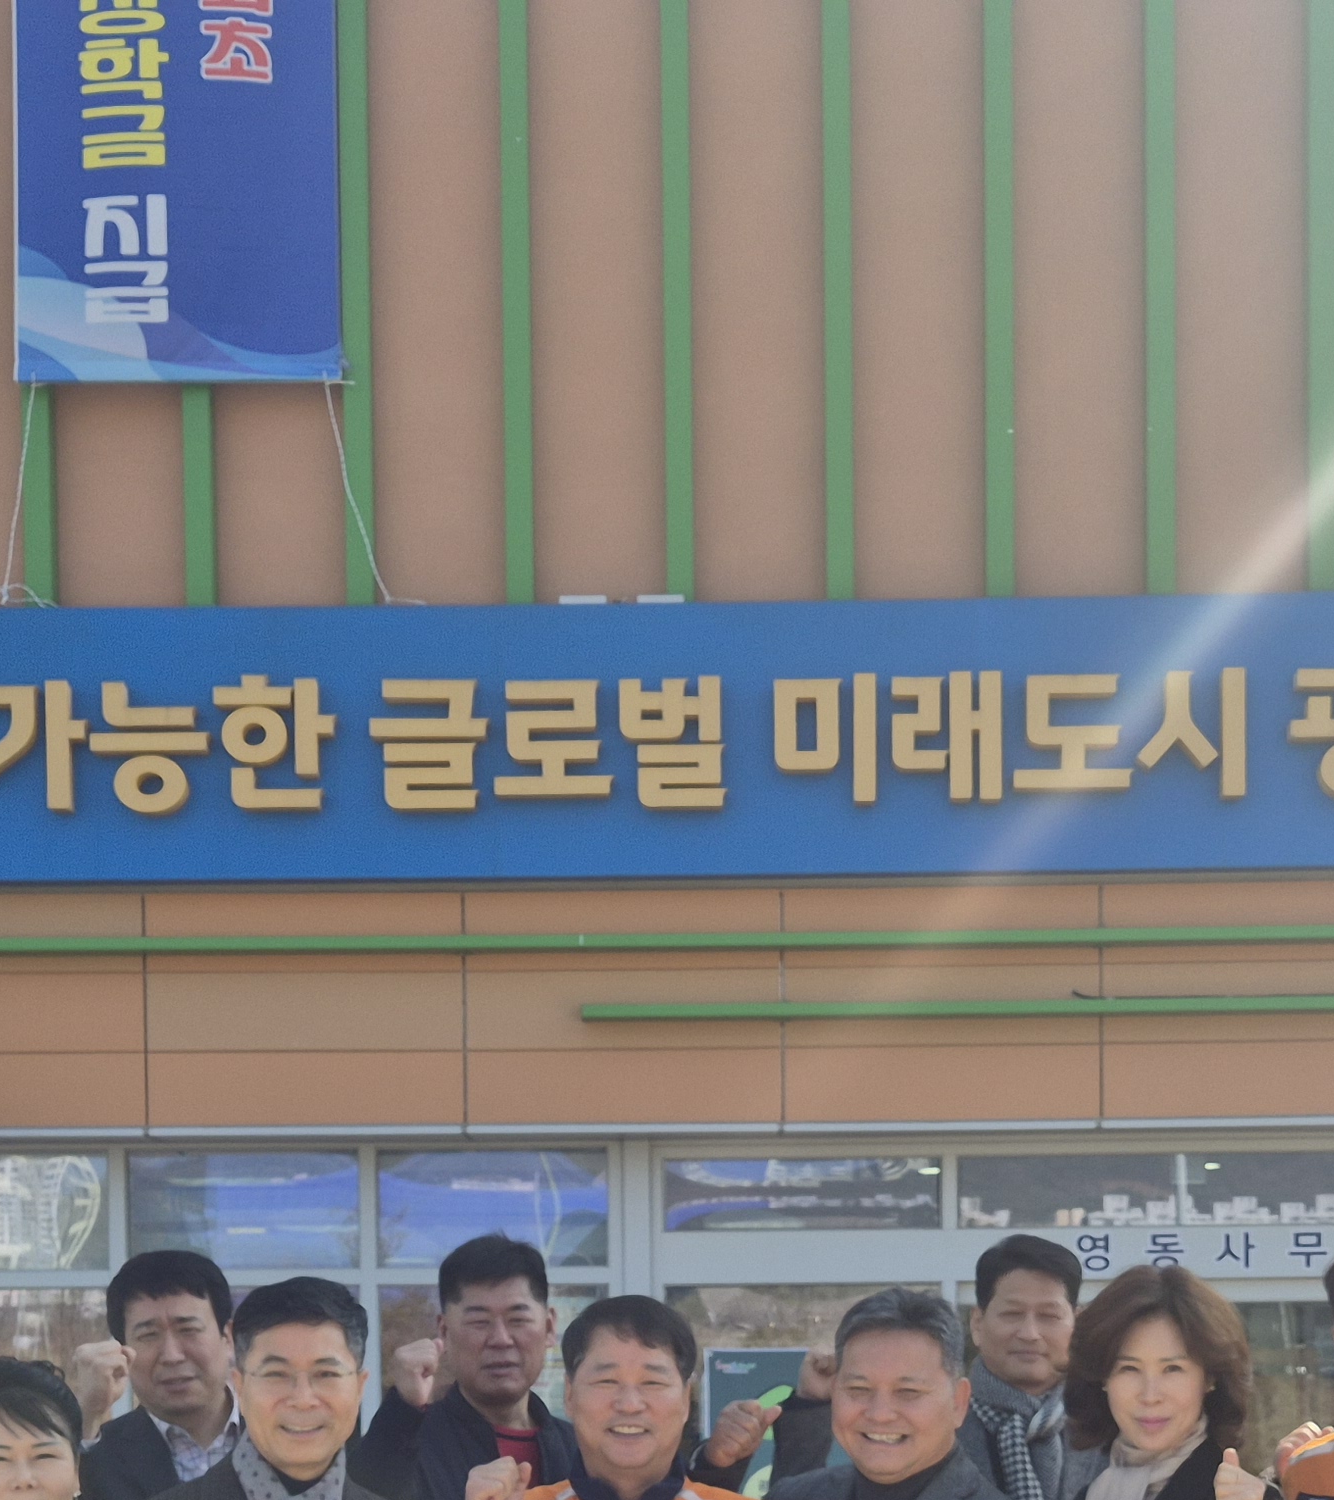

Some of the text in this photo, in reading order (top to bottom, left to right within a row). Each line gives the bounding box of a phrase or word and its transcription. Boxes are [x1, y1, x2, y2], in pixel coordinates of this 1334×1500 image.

[198, 0, 274, 84] 초
[82, 193, 169, 323] 지급
[369, 674, 730, 814] 글로벌
[772, 667, 1249, 804] 미래도시
